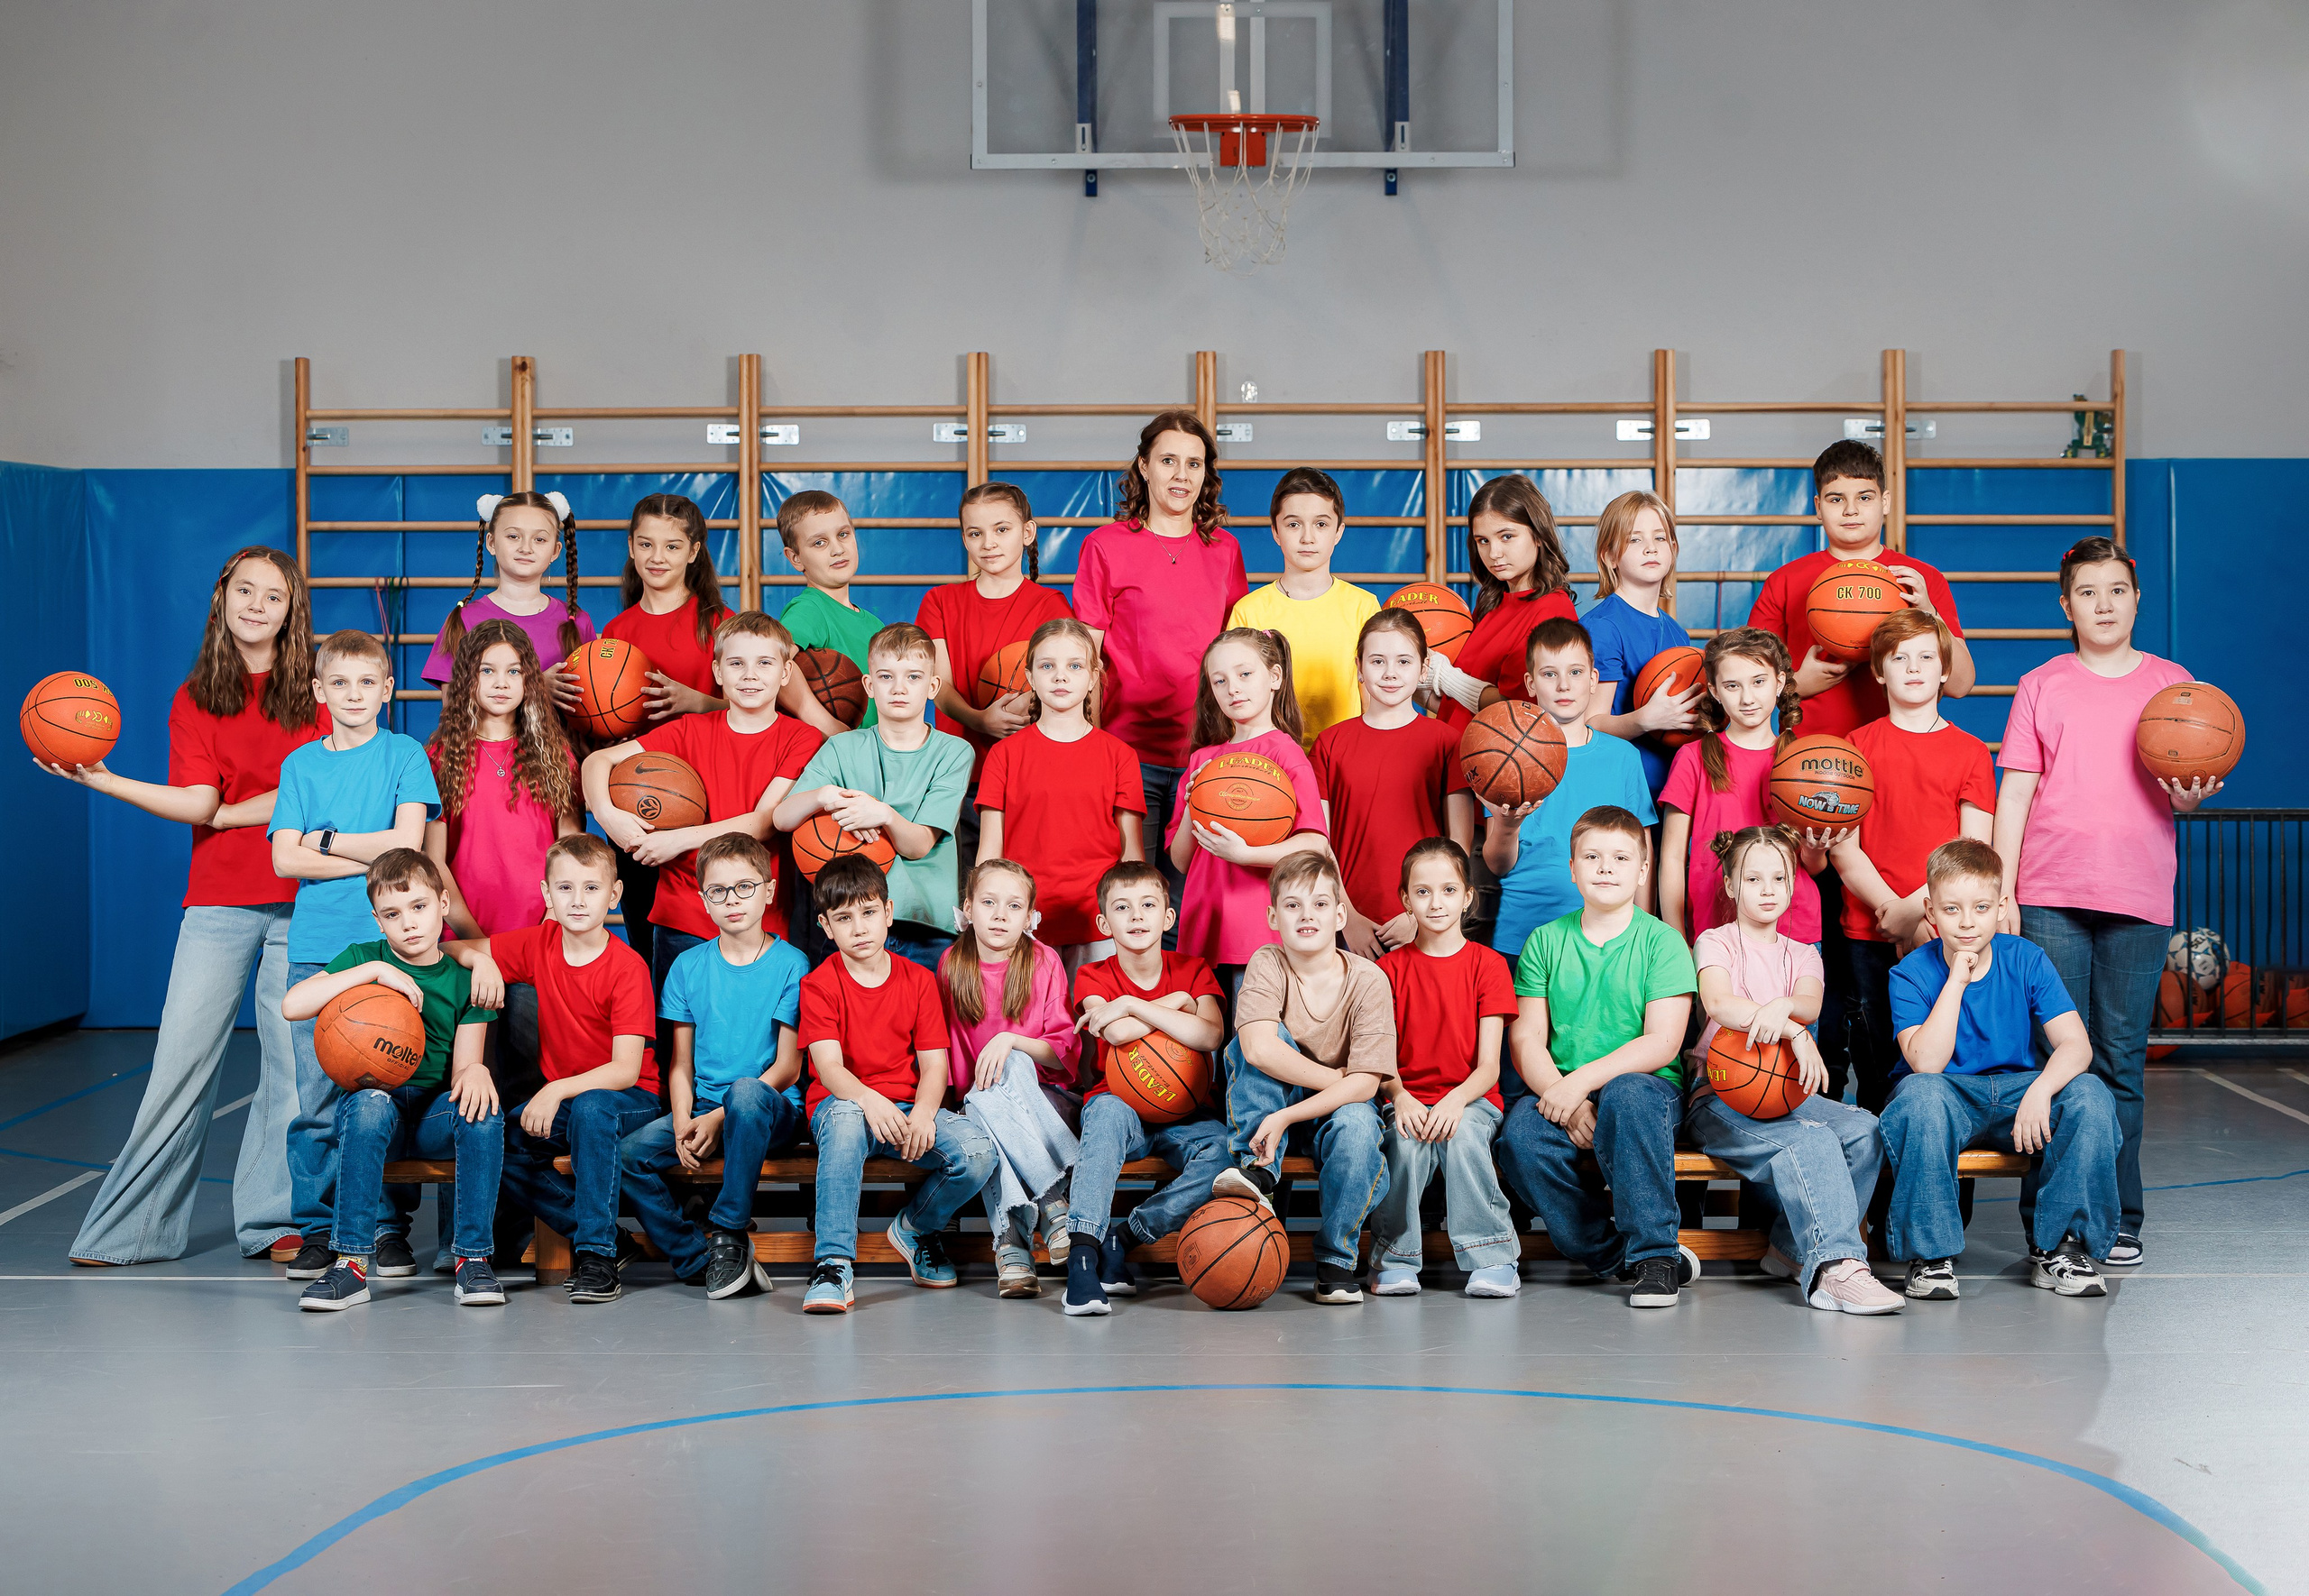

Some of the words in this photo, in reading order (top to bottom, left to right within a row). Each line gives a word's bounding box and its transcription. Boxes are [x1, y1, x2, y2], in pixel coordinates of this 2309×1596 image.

[1386, 592, 1440, 610] EADER
[1836, 585, 1854, 601] CK
[1858, 585, 1882, 601] 700
[600, 647, 615, 659] CK
[73, 677, 99, 690] 500
[1219, 757, 1281, 782] LEADER
[1800, 757, 1864, 778] mottle
[1798, 793, 1826, 812] NOW
[1837, 803, 1860, 815] TIME
[373, 1037, 422, 1067] molten
[386, 1058, 409, 1071] OFFICIAL
[1127, 1044, 1179, 1103] LEADER
